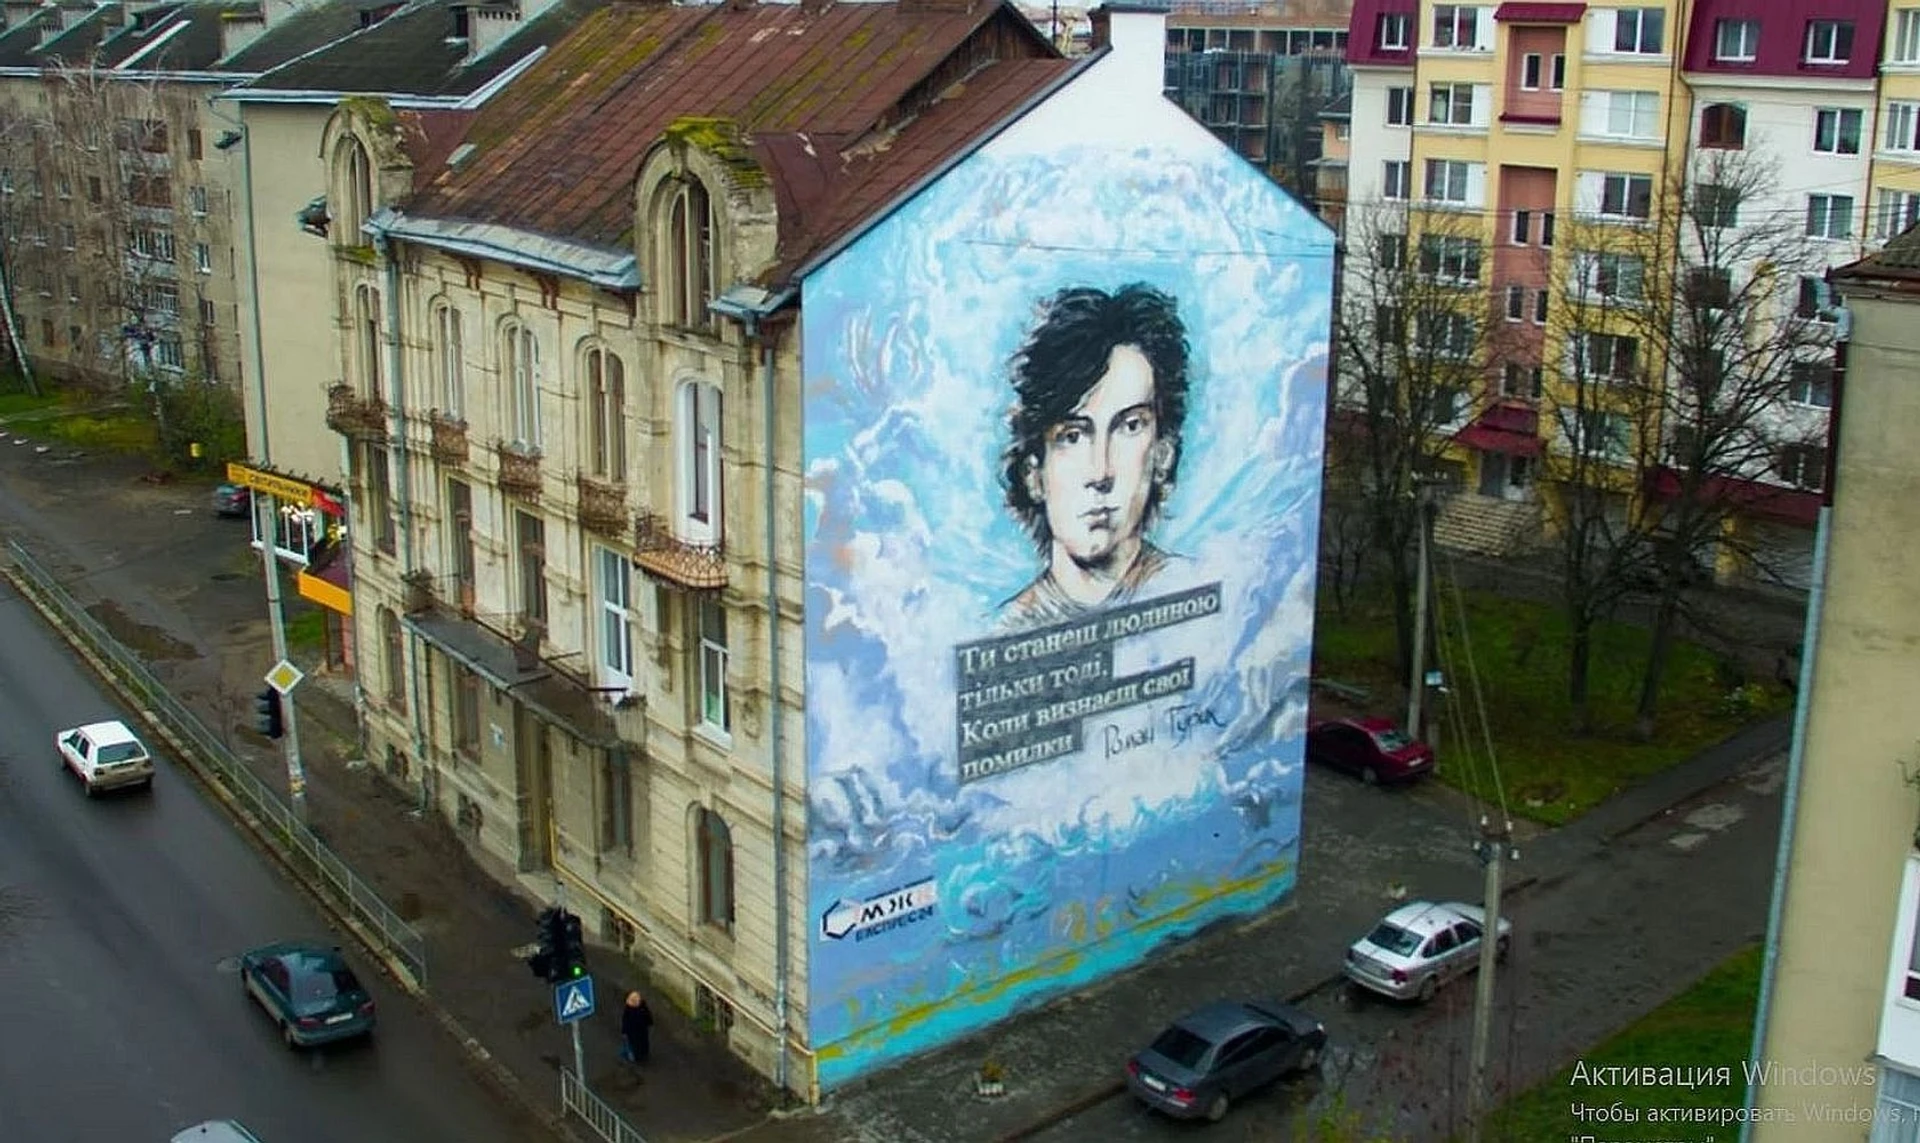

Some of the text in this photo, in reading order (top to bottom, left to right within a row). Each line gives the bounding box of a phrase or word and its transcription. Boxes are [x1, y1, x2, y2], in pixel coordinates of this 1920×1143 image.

[959, 592, 1218, 674] Ти станеш людиною
[960, 673, 1045, 712] тільки
[961, 661, 1192, 749] Коли визнаєш свої
[962, 733, 1074, 780] помилки
